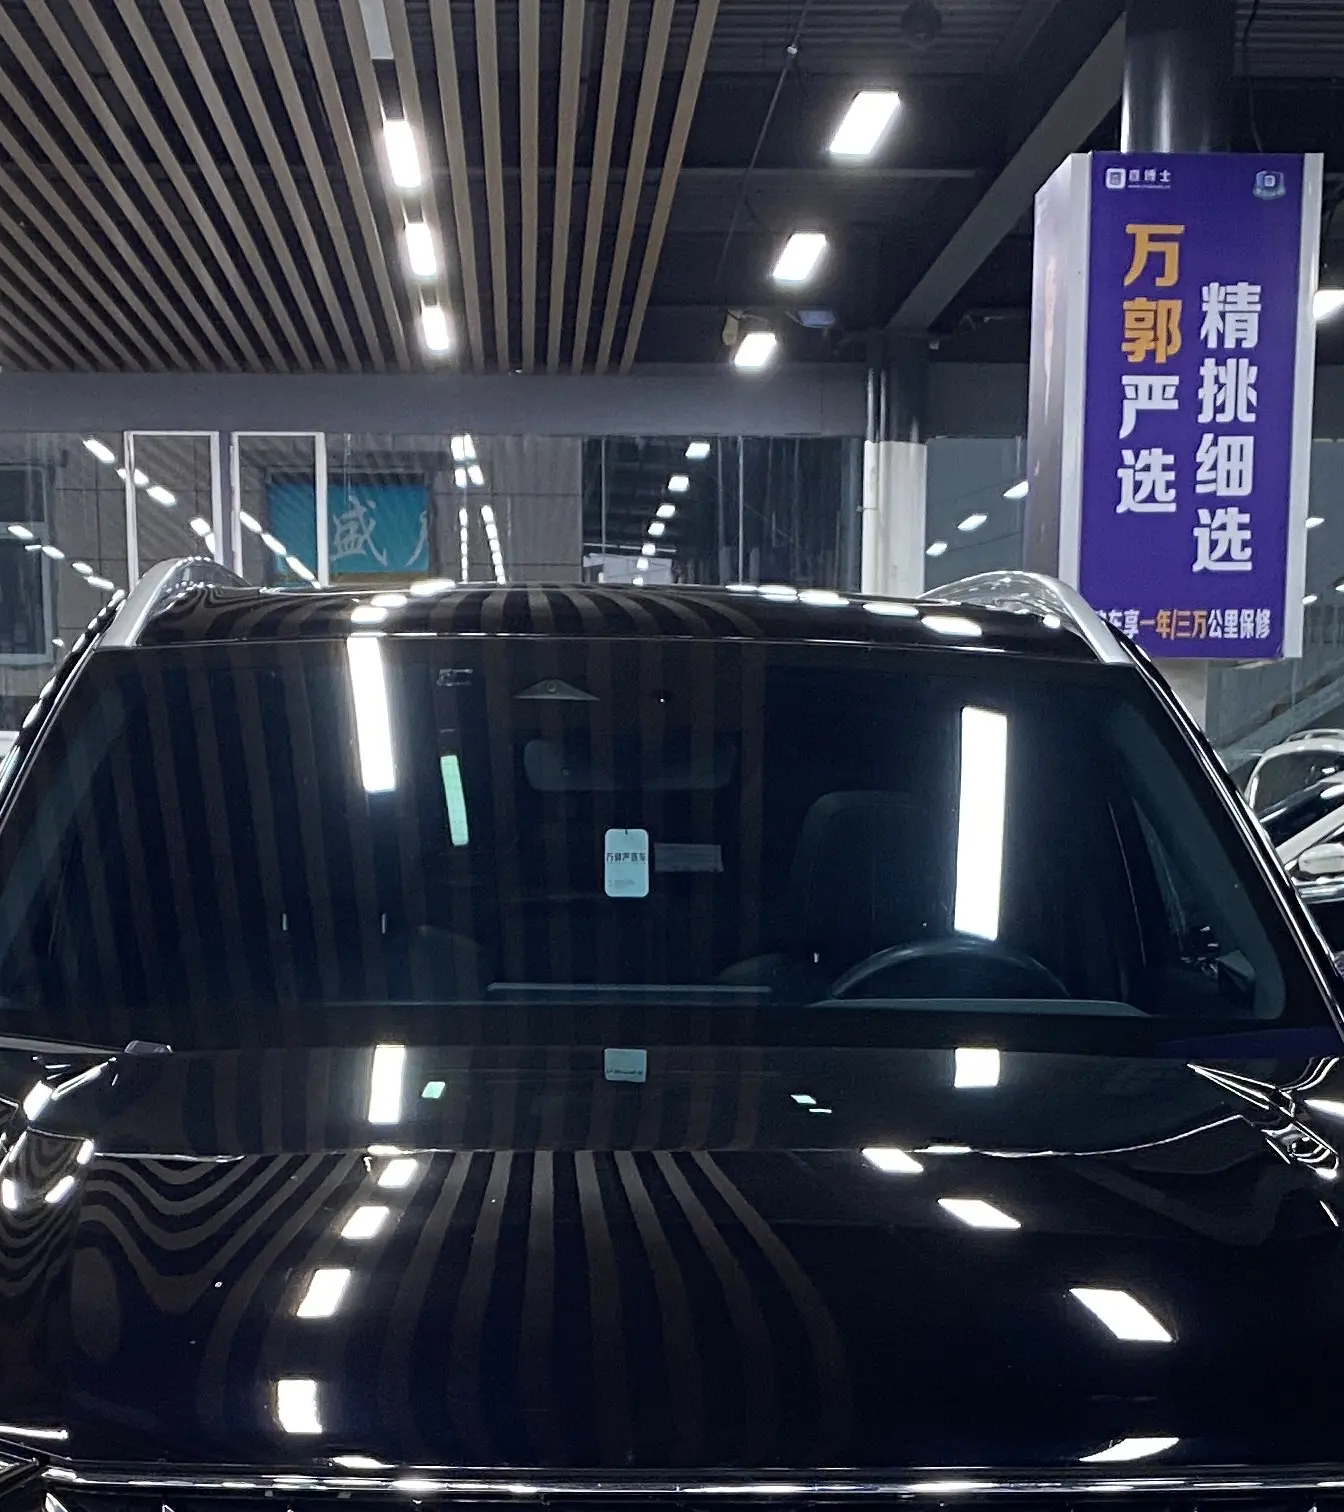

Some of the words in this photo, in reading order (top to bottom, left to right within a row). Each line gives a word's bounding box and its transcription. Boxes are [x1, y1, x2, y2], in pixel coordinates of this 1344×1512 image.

[1116, 223, 1186, 514] 万郭严选
[1191, 281, 1263, 572] 精挑细选
